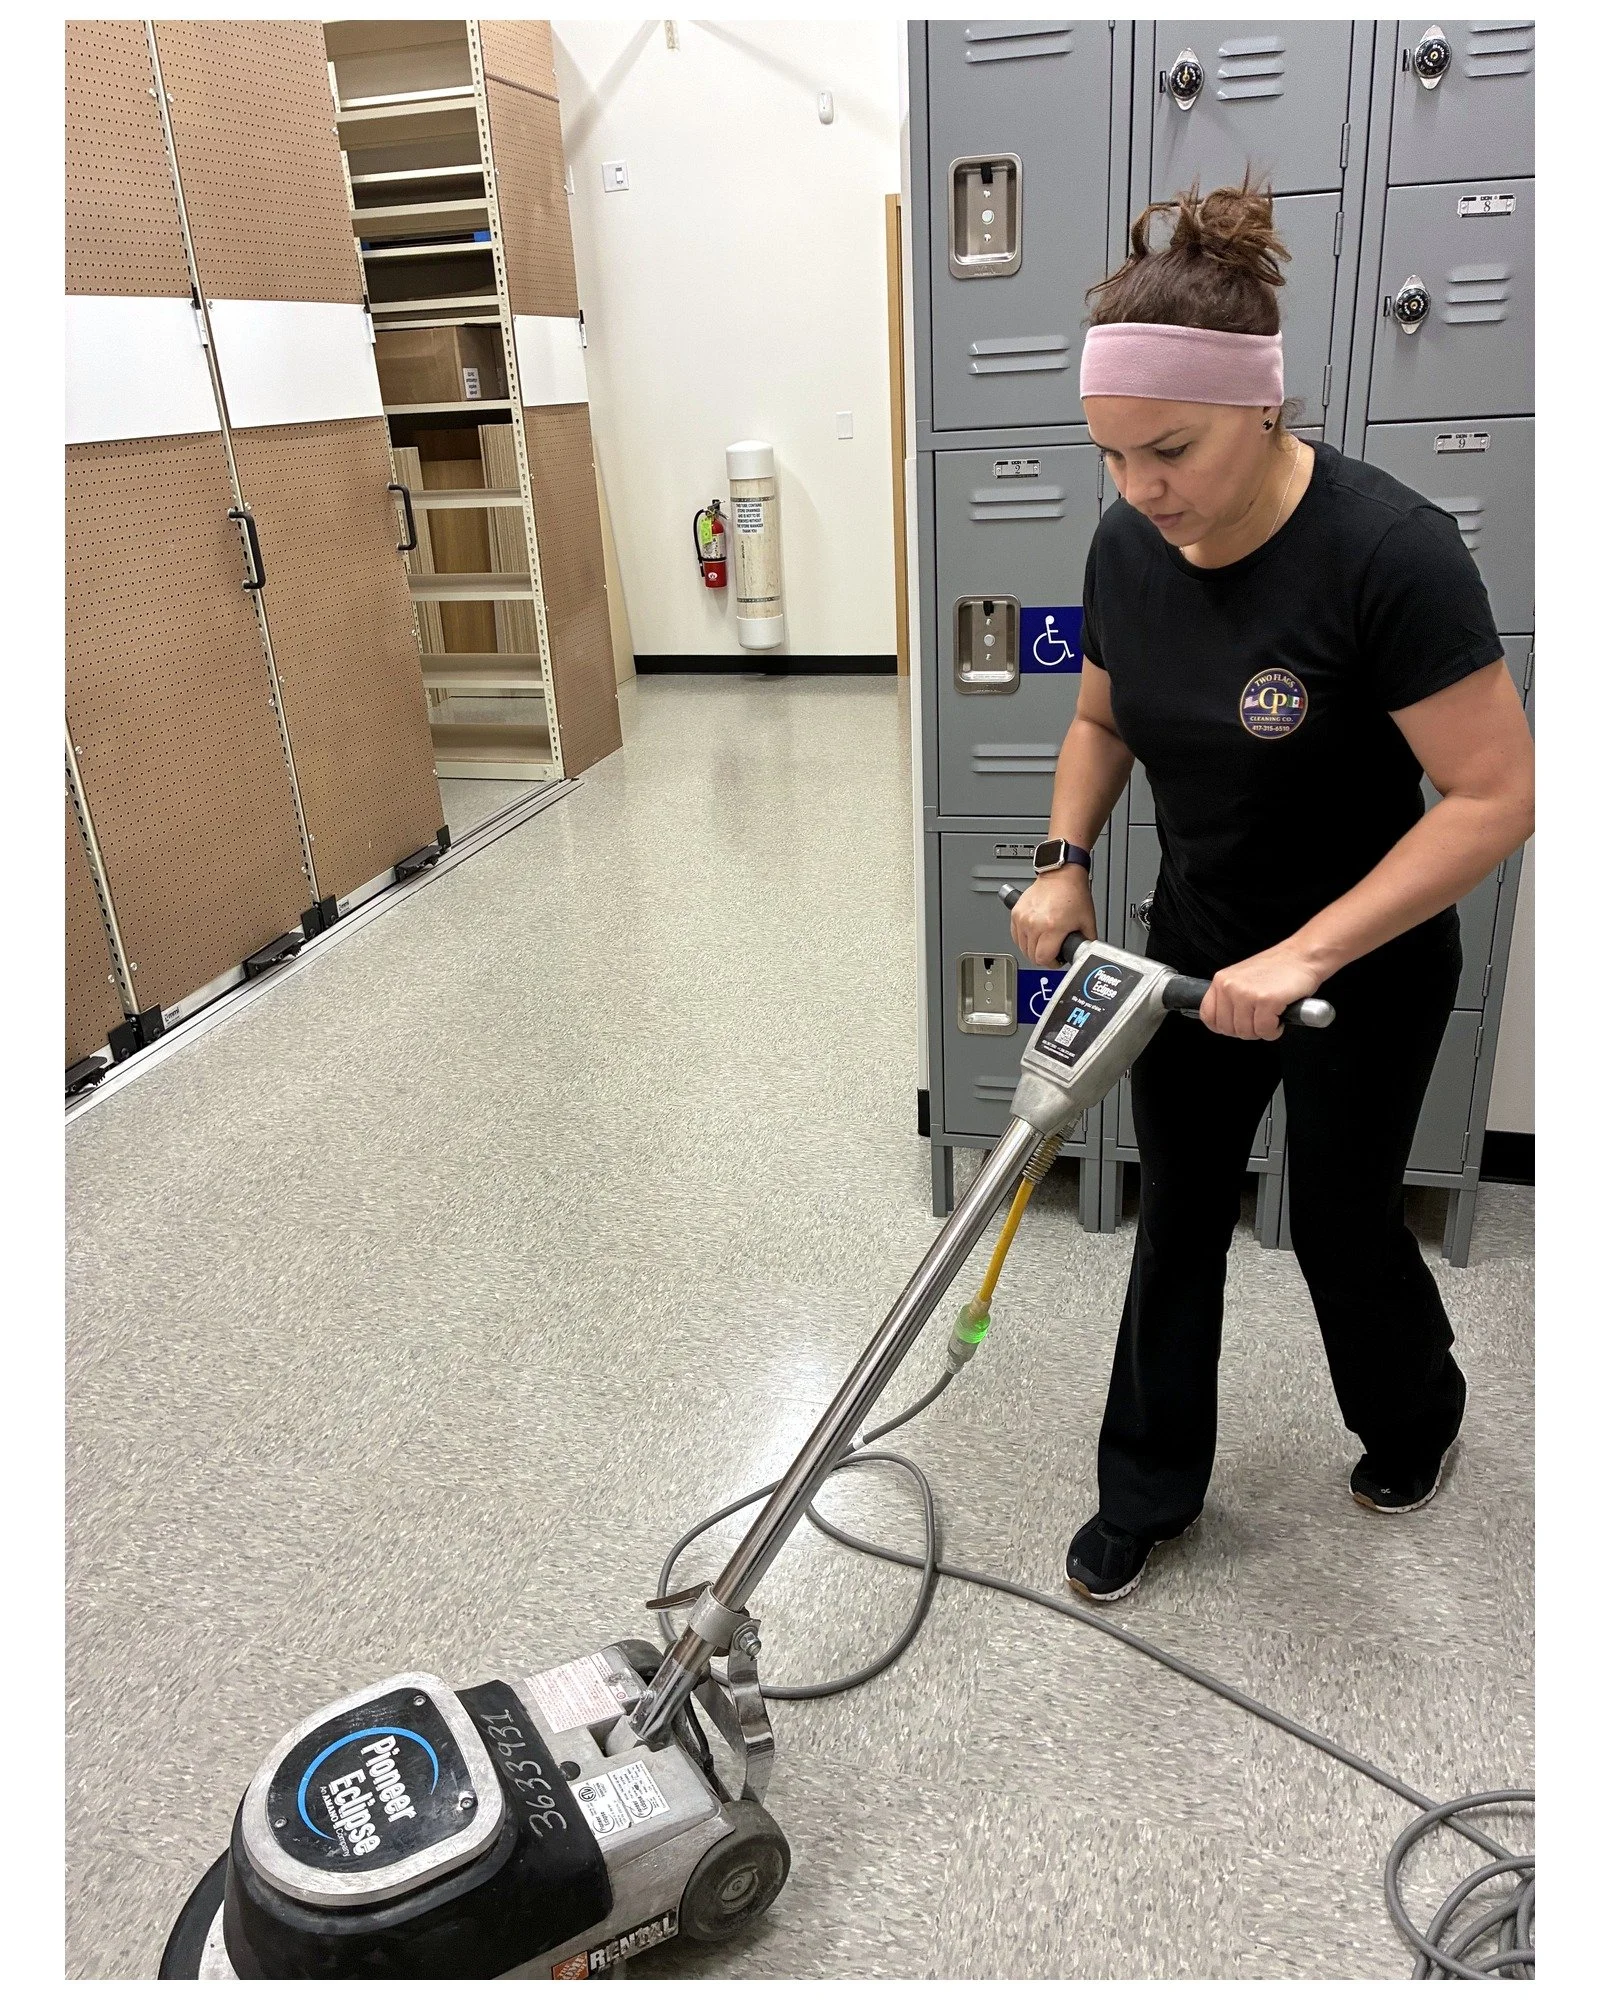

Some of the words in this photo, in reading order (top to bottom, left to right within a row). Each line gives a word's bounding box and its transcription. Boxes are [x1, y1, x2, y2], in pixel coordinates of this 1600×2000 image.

[1483, 200, 1491, 212] 8
[1458, 439, 1466, 449] 9
[1254, 674, 1273, 687] TWO
[1273, 673, 1296, 688] FLAGS
[1094, 969, 1122, 987] Pioneer
[1092, 980, 1118, 999] Eclipse
[1066, 1007, 1091, 1028] FM
[360, 1735, 417, 1823] Pioneer
[480, 1708, 567, 1838] 3633931
[319, 1786, 329, 1795] An
[321, 1794, 339, 1823] AMANO
[328, 1768, 381, 1856] Eclipse
[335, 1827, 351, 1857] Company
